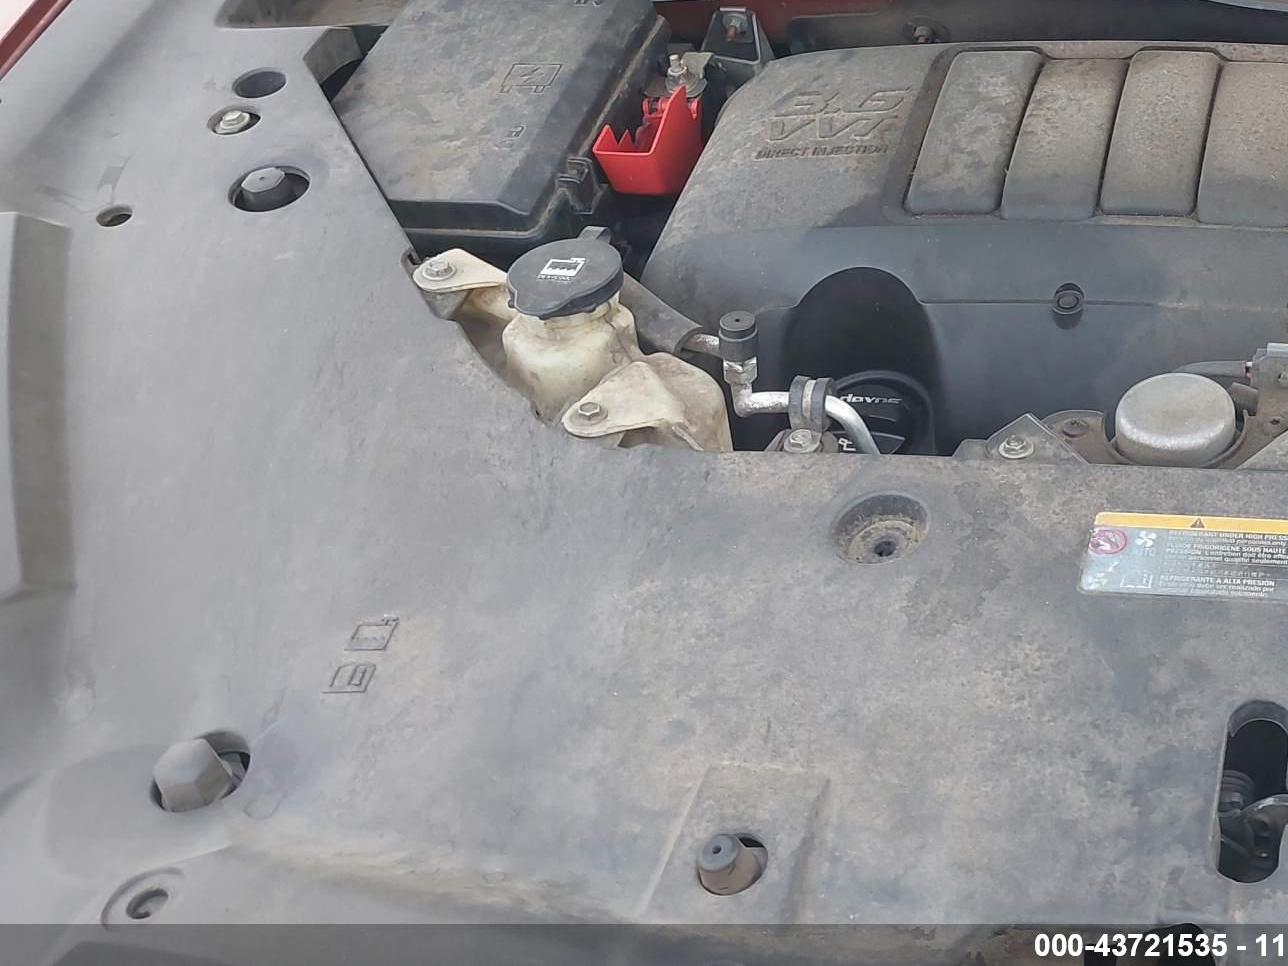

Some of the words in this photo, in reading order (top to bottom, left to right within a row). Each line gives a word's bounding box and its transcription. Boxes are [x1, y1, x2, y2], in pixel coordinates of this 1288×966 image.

[767, 115, 898, 142] VVT
[755, 145, 809, 160] DIRECT
[811, 143, 890, 157] INJECTION
